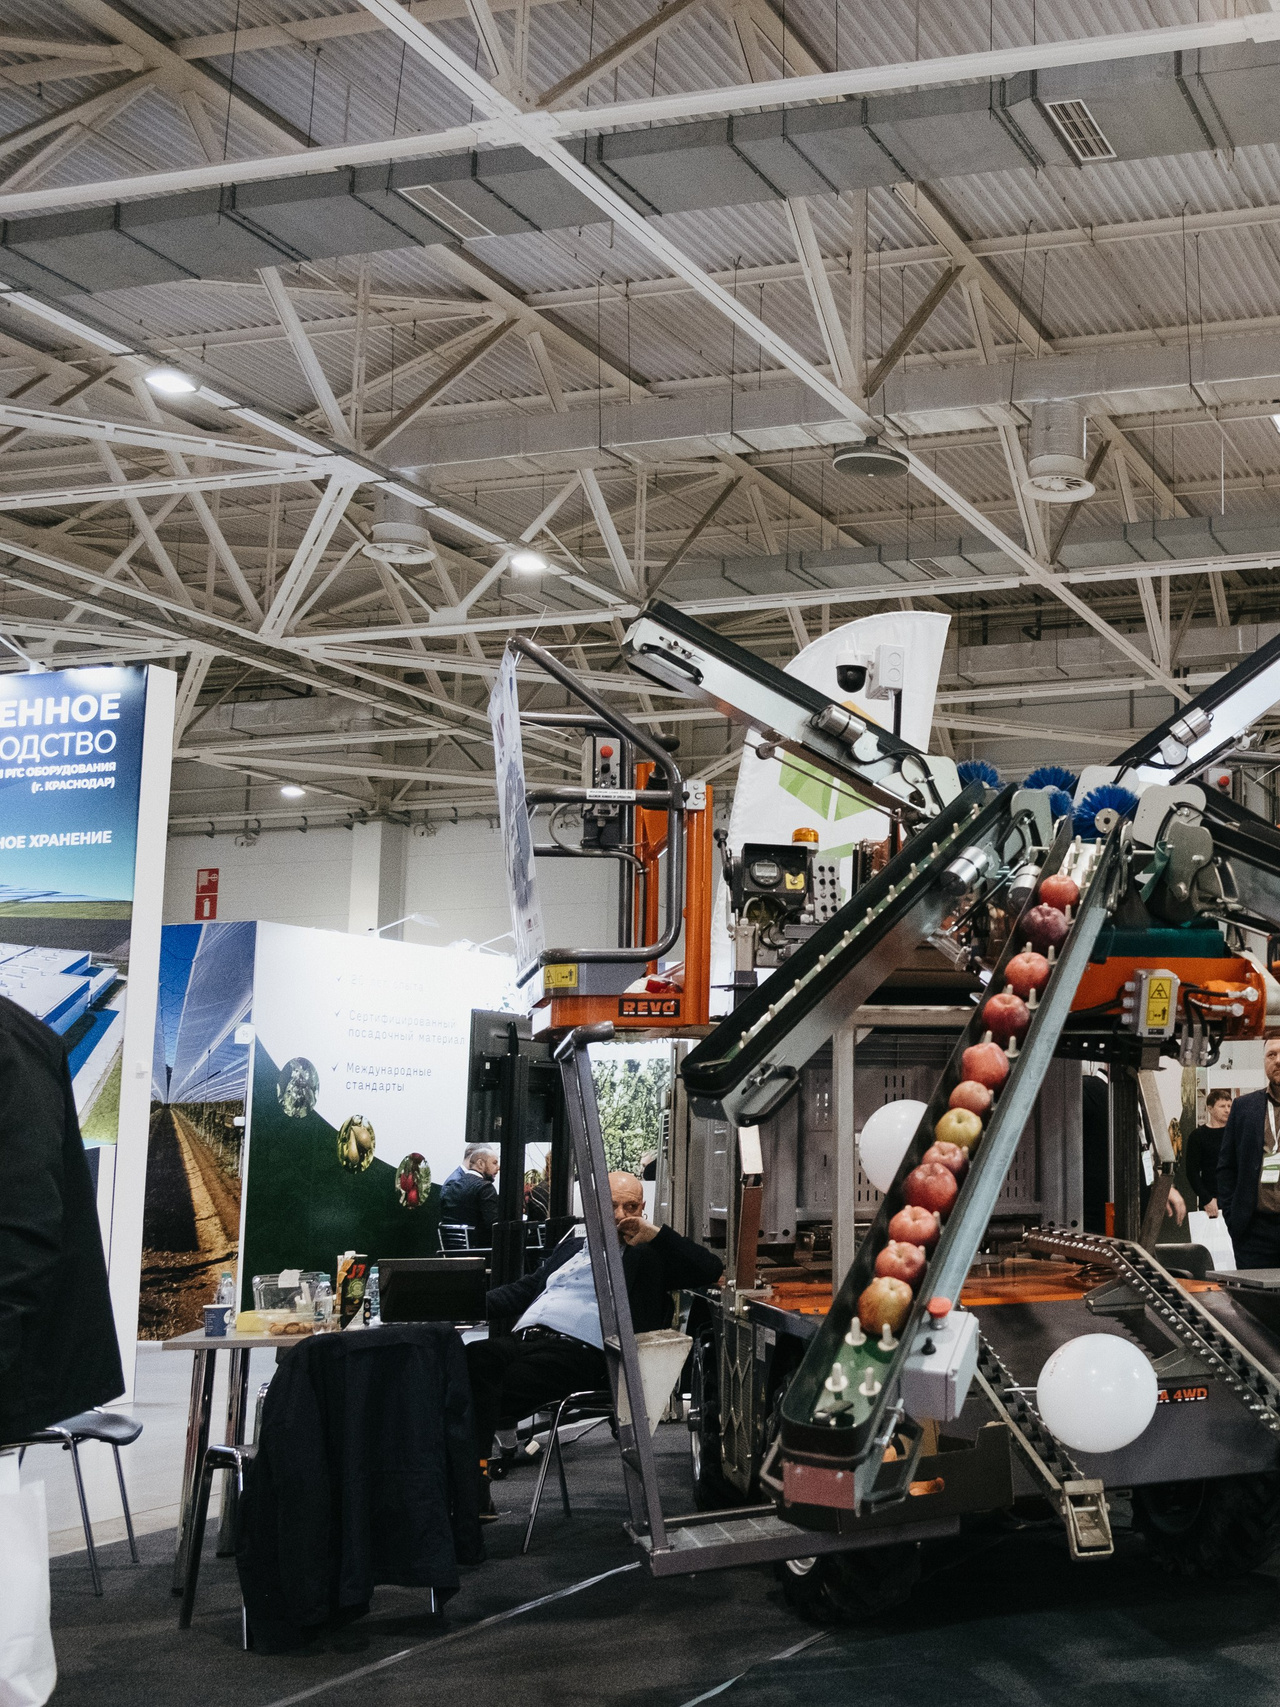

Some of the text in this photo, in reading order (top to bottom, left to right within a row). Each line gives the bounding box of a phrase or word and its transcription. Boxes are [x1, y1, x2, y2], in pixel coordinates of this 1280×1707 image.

[0, 693, 121, 728] ЕННОЕ
[0, 730, 117, 764] ОДСТВО
[5, 767, 26, 779] РГС
[26, 762, 117, 777] ОБОРУДОВАНИЯ
[45, 777, 116, 791] КРАСНОДАР)
[29, 830, 112, 848] ХРАНЕНИЕ
[349, 1009, 456, 1029] Сертифицированный
[348, 1027, 465, 1046] посадочный материал
[346, 1062, 432, 1077] Международные
[346, 1080, 405, 1092] стандарты
[346, 1264, 366, 1279] J7
[1173, 1387, 1208, 1400] 4WD
